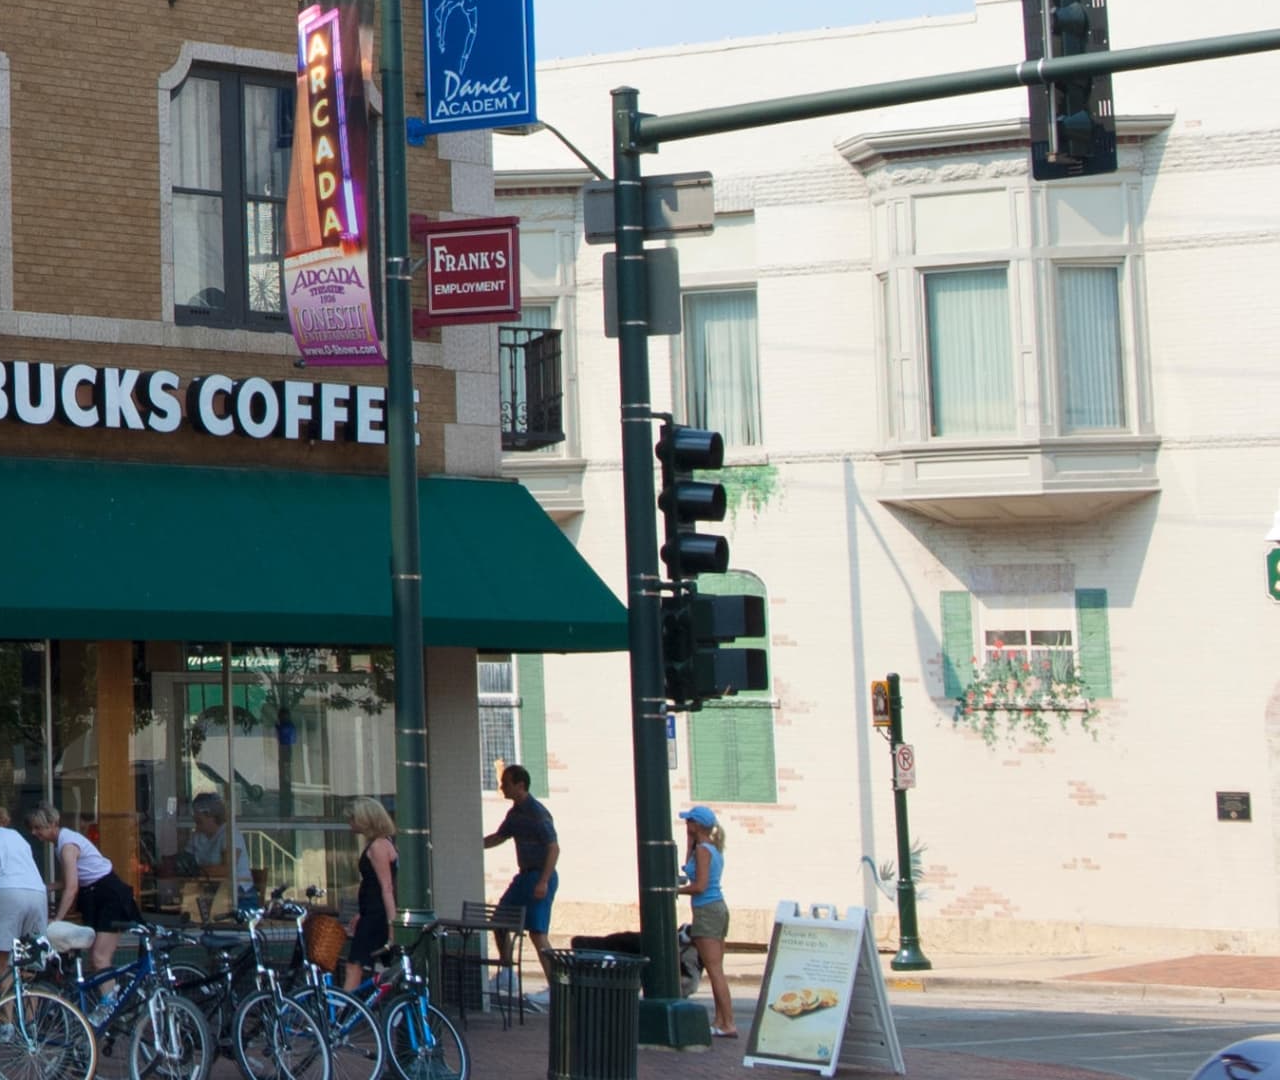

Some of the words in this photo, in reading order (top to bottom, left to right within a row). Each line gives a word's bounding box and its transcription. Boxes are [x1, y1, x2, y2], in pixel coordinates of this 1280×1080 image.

[443, 70, 511, 102] Dance
[436, 93, 521, 117] ACADEMY
[307, 32, 343, 238] ARCADA
[434, 245, 506, 273] FRANK'S
[291, 265, 365, 295] ARCADA
[434, 280, 506, 296] EMPLOYMENT
[301, 304, 365, 331] ONESTI
[199, 373, 421, 446] COFFE
